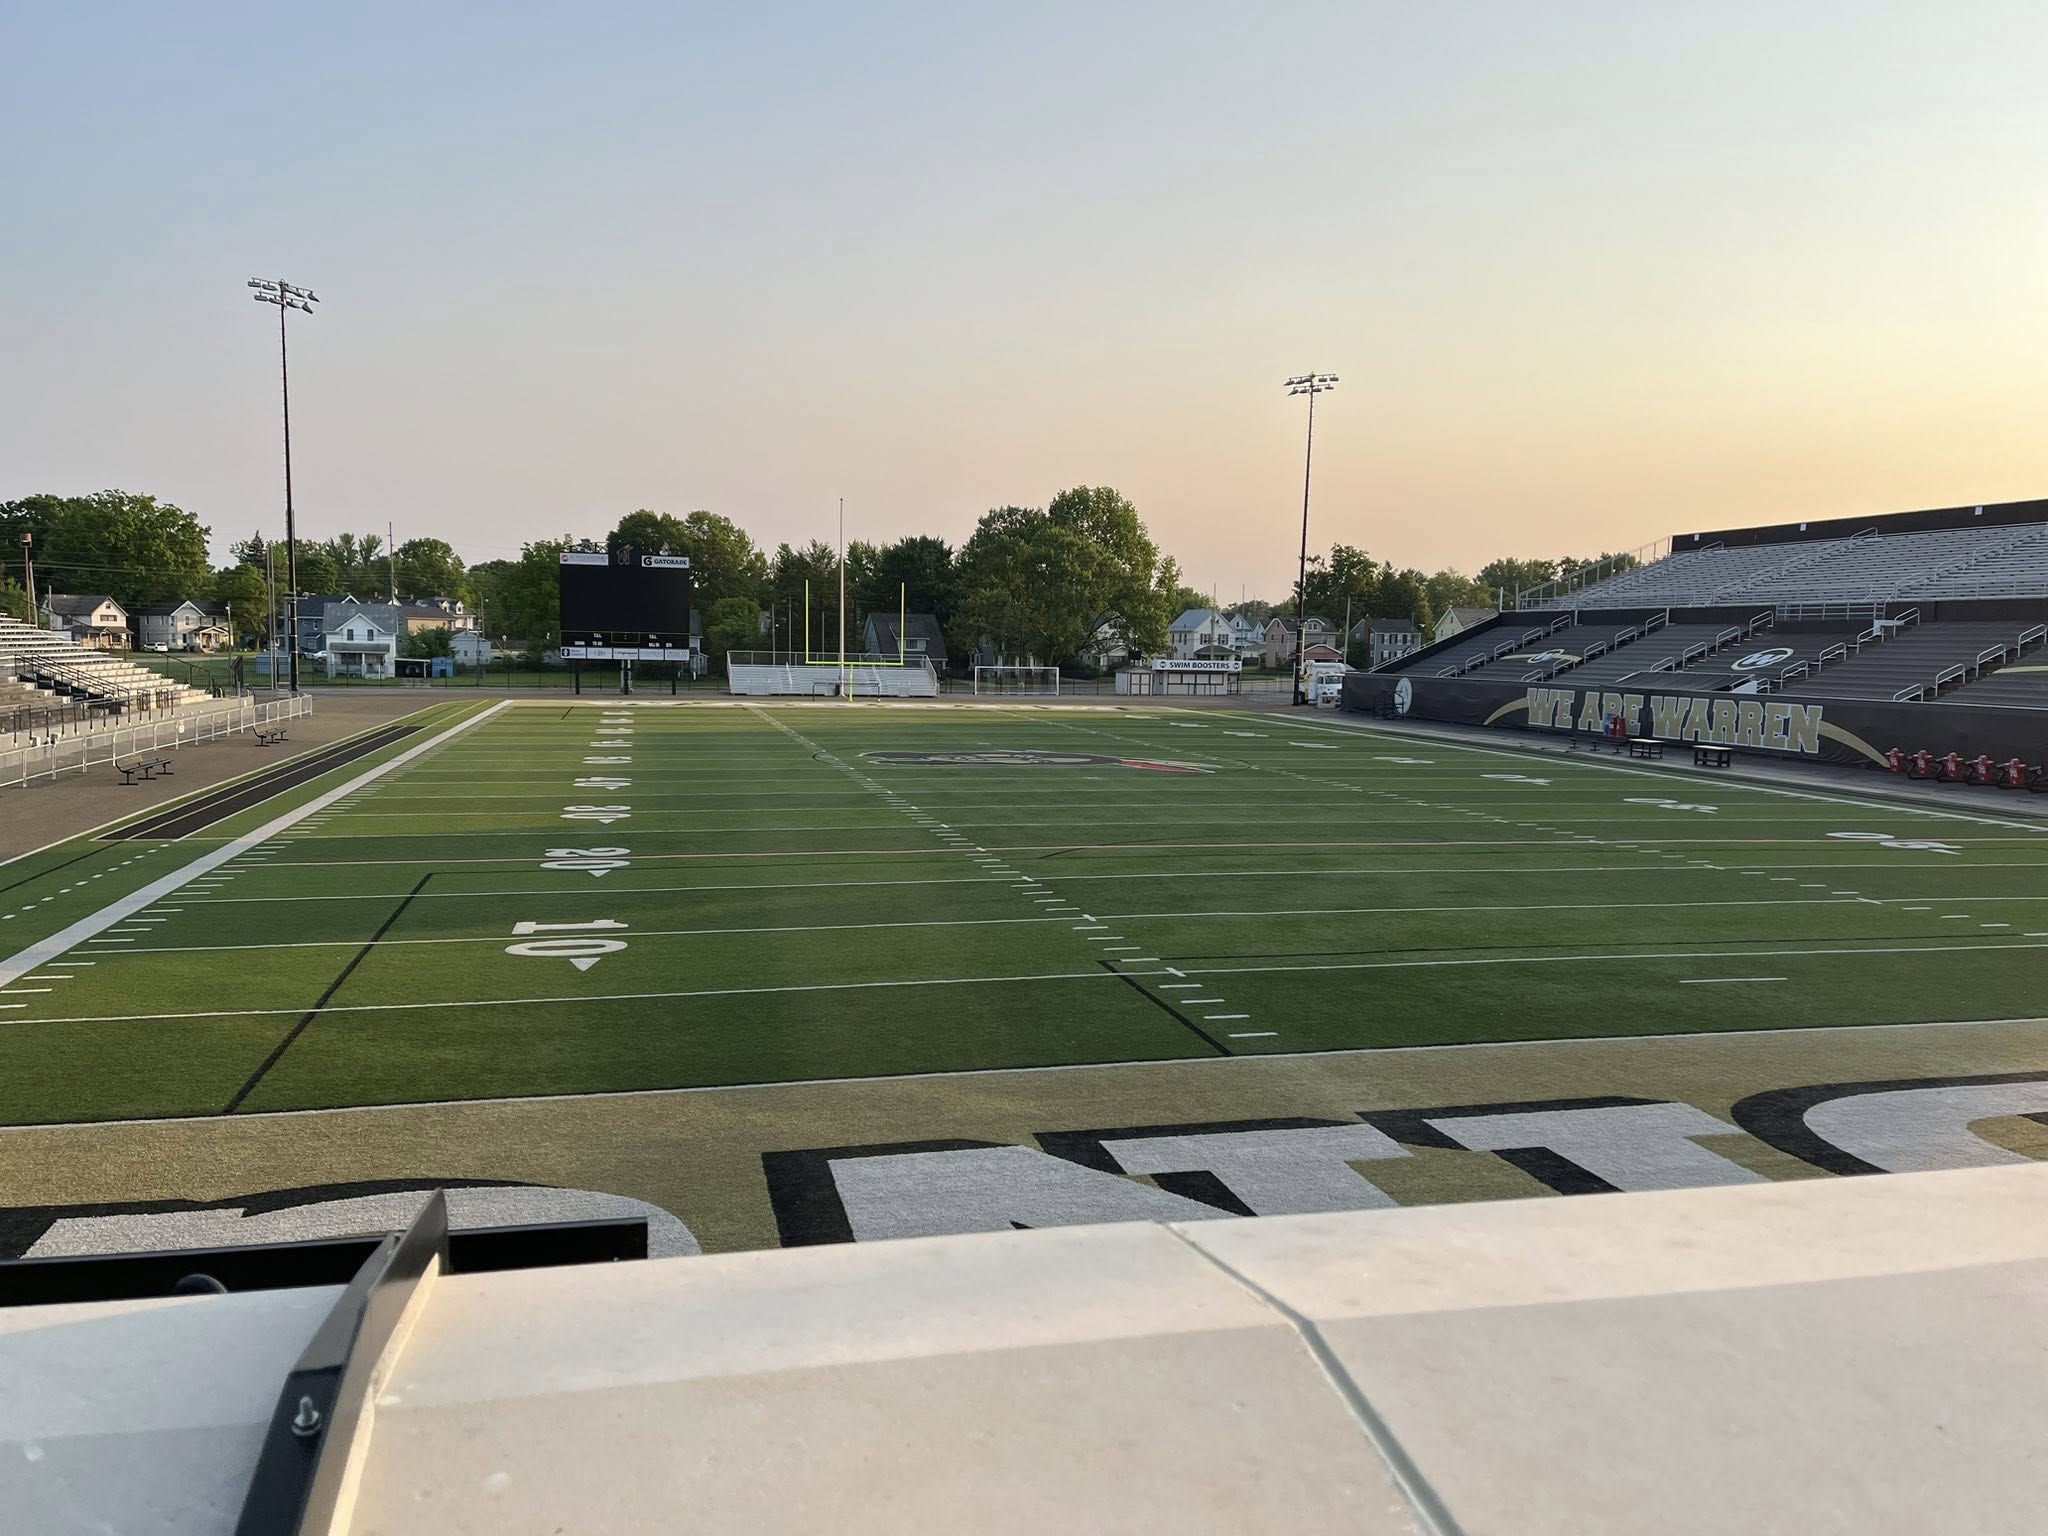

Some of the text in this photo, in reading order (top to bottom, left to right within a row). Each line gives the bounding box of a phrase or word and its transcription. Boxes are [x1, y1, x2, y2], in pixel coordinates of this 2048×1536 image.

[653, 558, 688, 566] GATORADE
[1169, 661, 1230, 670] SWIM BOOSTERS
[1526, 687, 1824, 754] WE ARE WARREN
[539, 847, 632, 870] 20
[504, 919, 629, 957] 10
